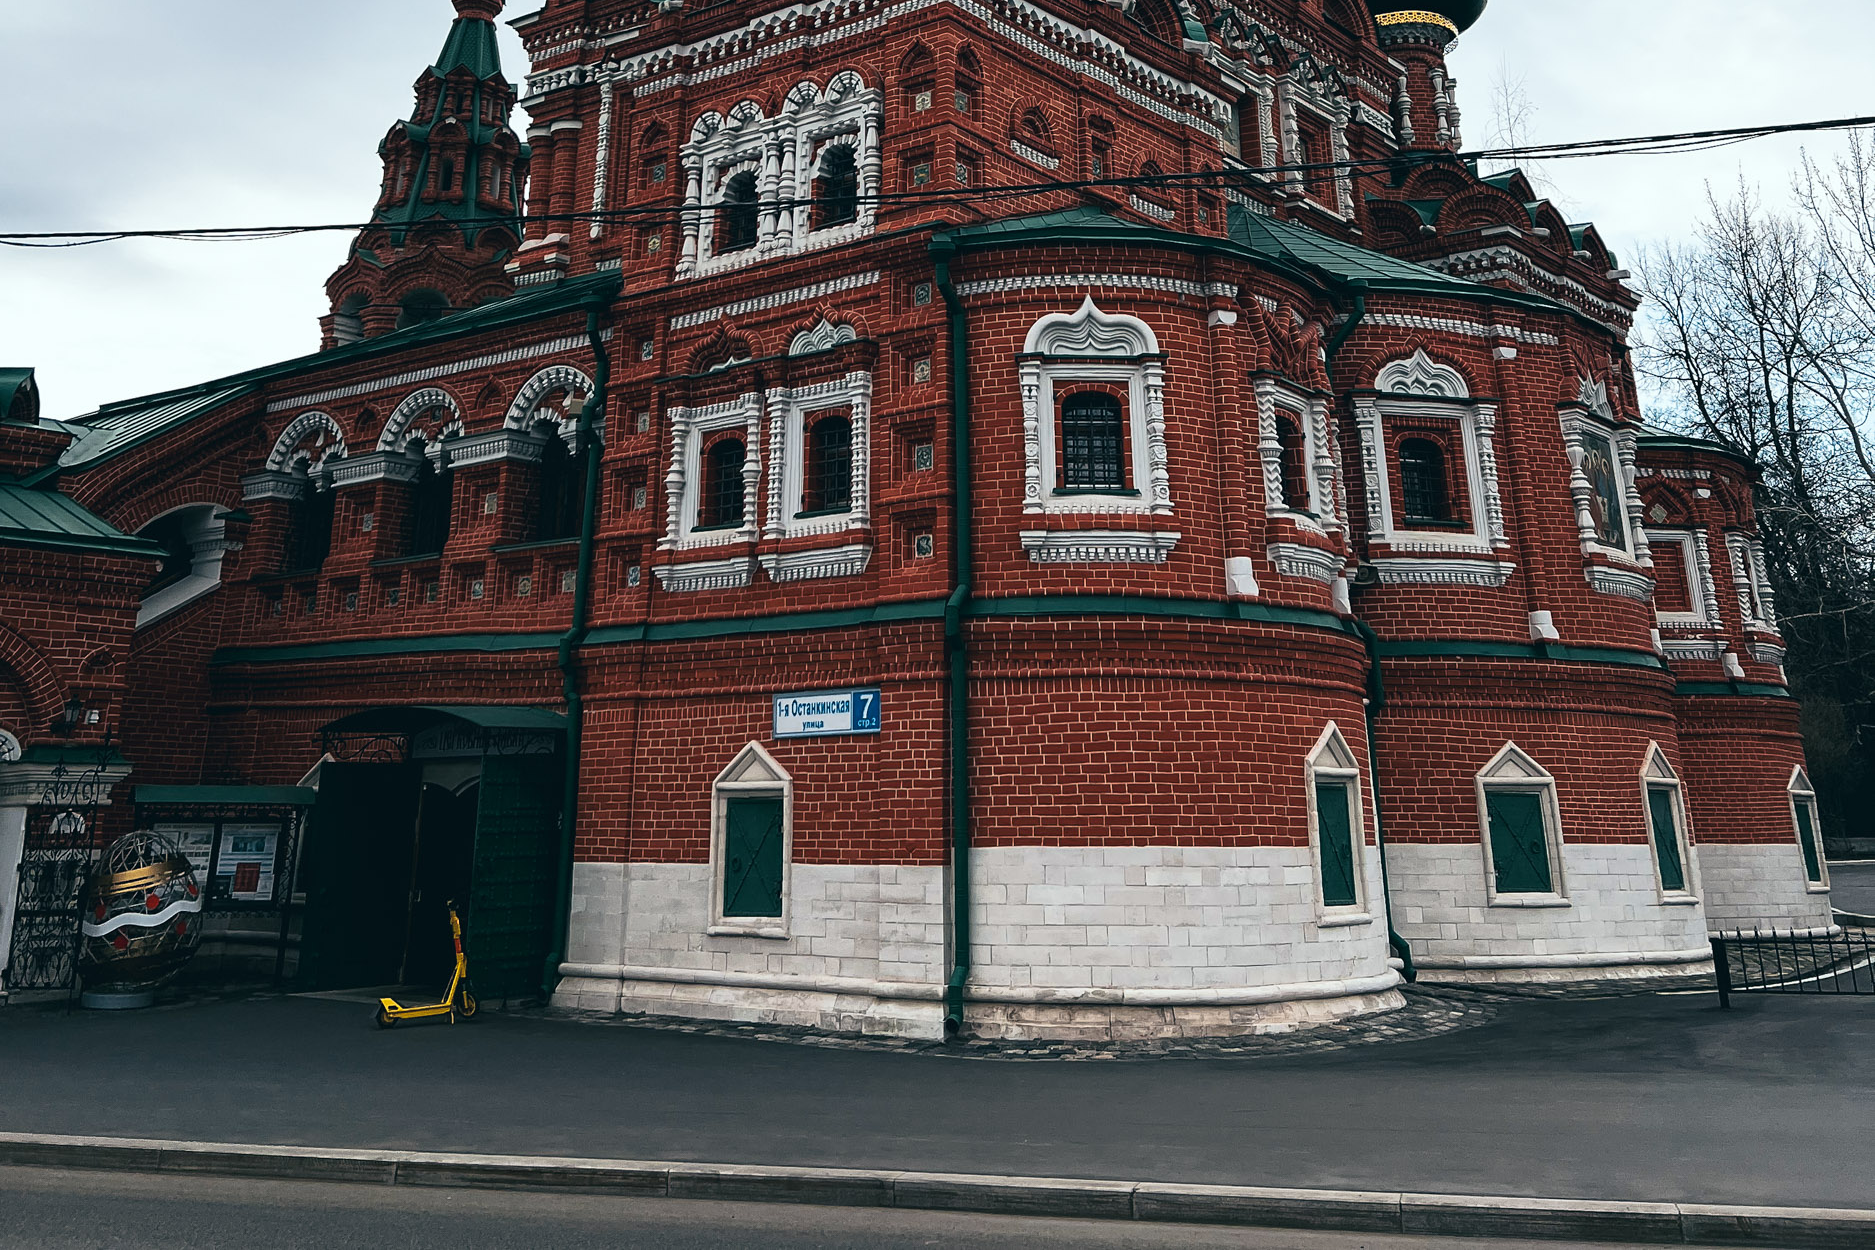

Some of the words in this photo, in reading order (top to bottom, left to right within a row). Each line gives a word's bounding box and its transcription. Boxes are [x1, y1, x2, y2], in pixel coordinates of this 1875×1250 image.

[778, 701, 789, 717] 1-я
[791, 699, 850, 717] Останкинская
[860, 693, 874, 719] 7
[802, 720, 824, 731] улица
